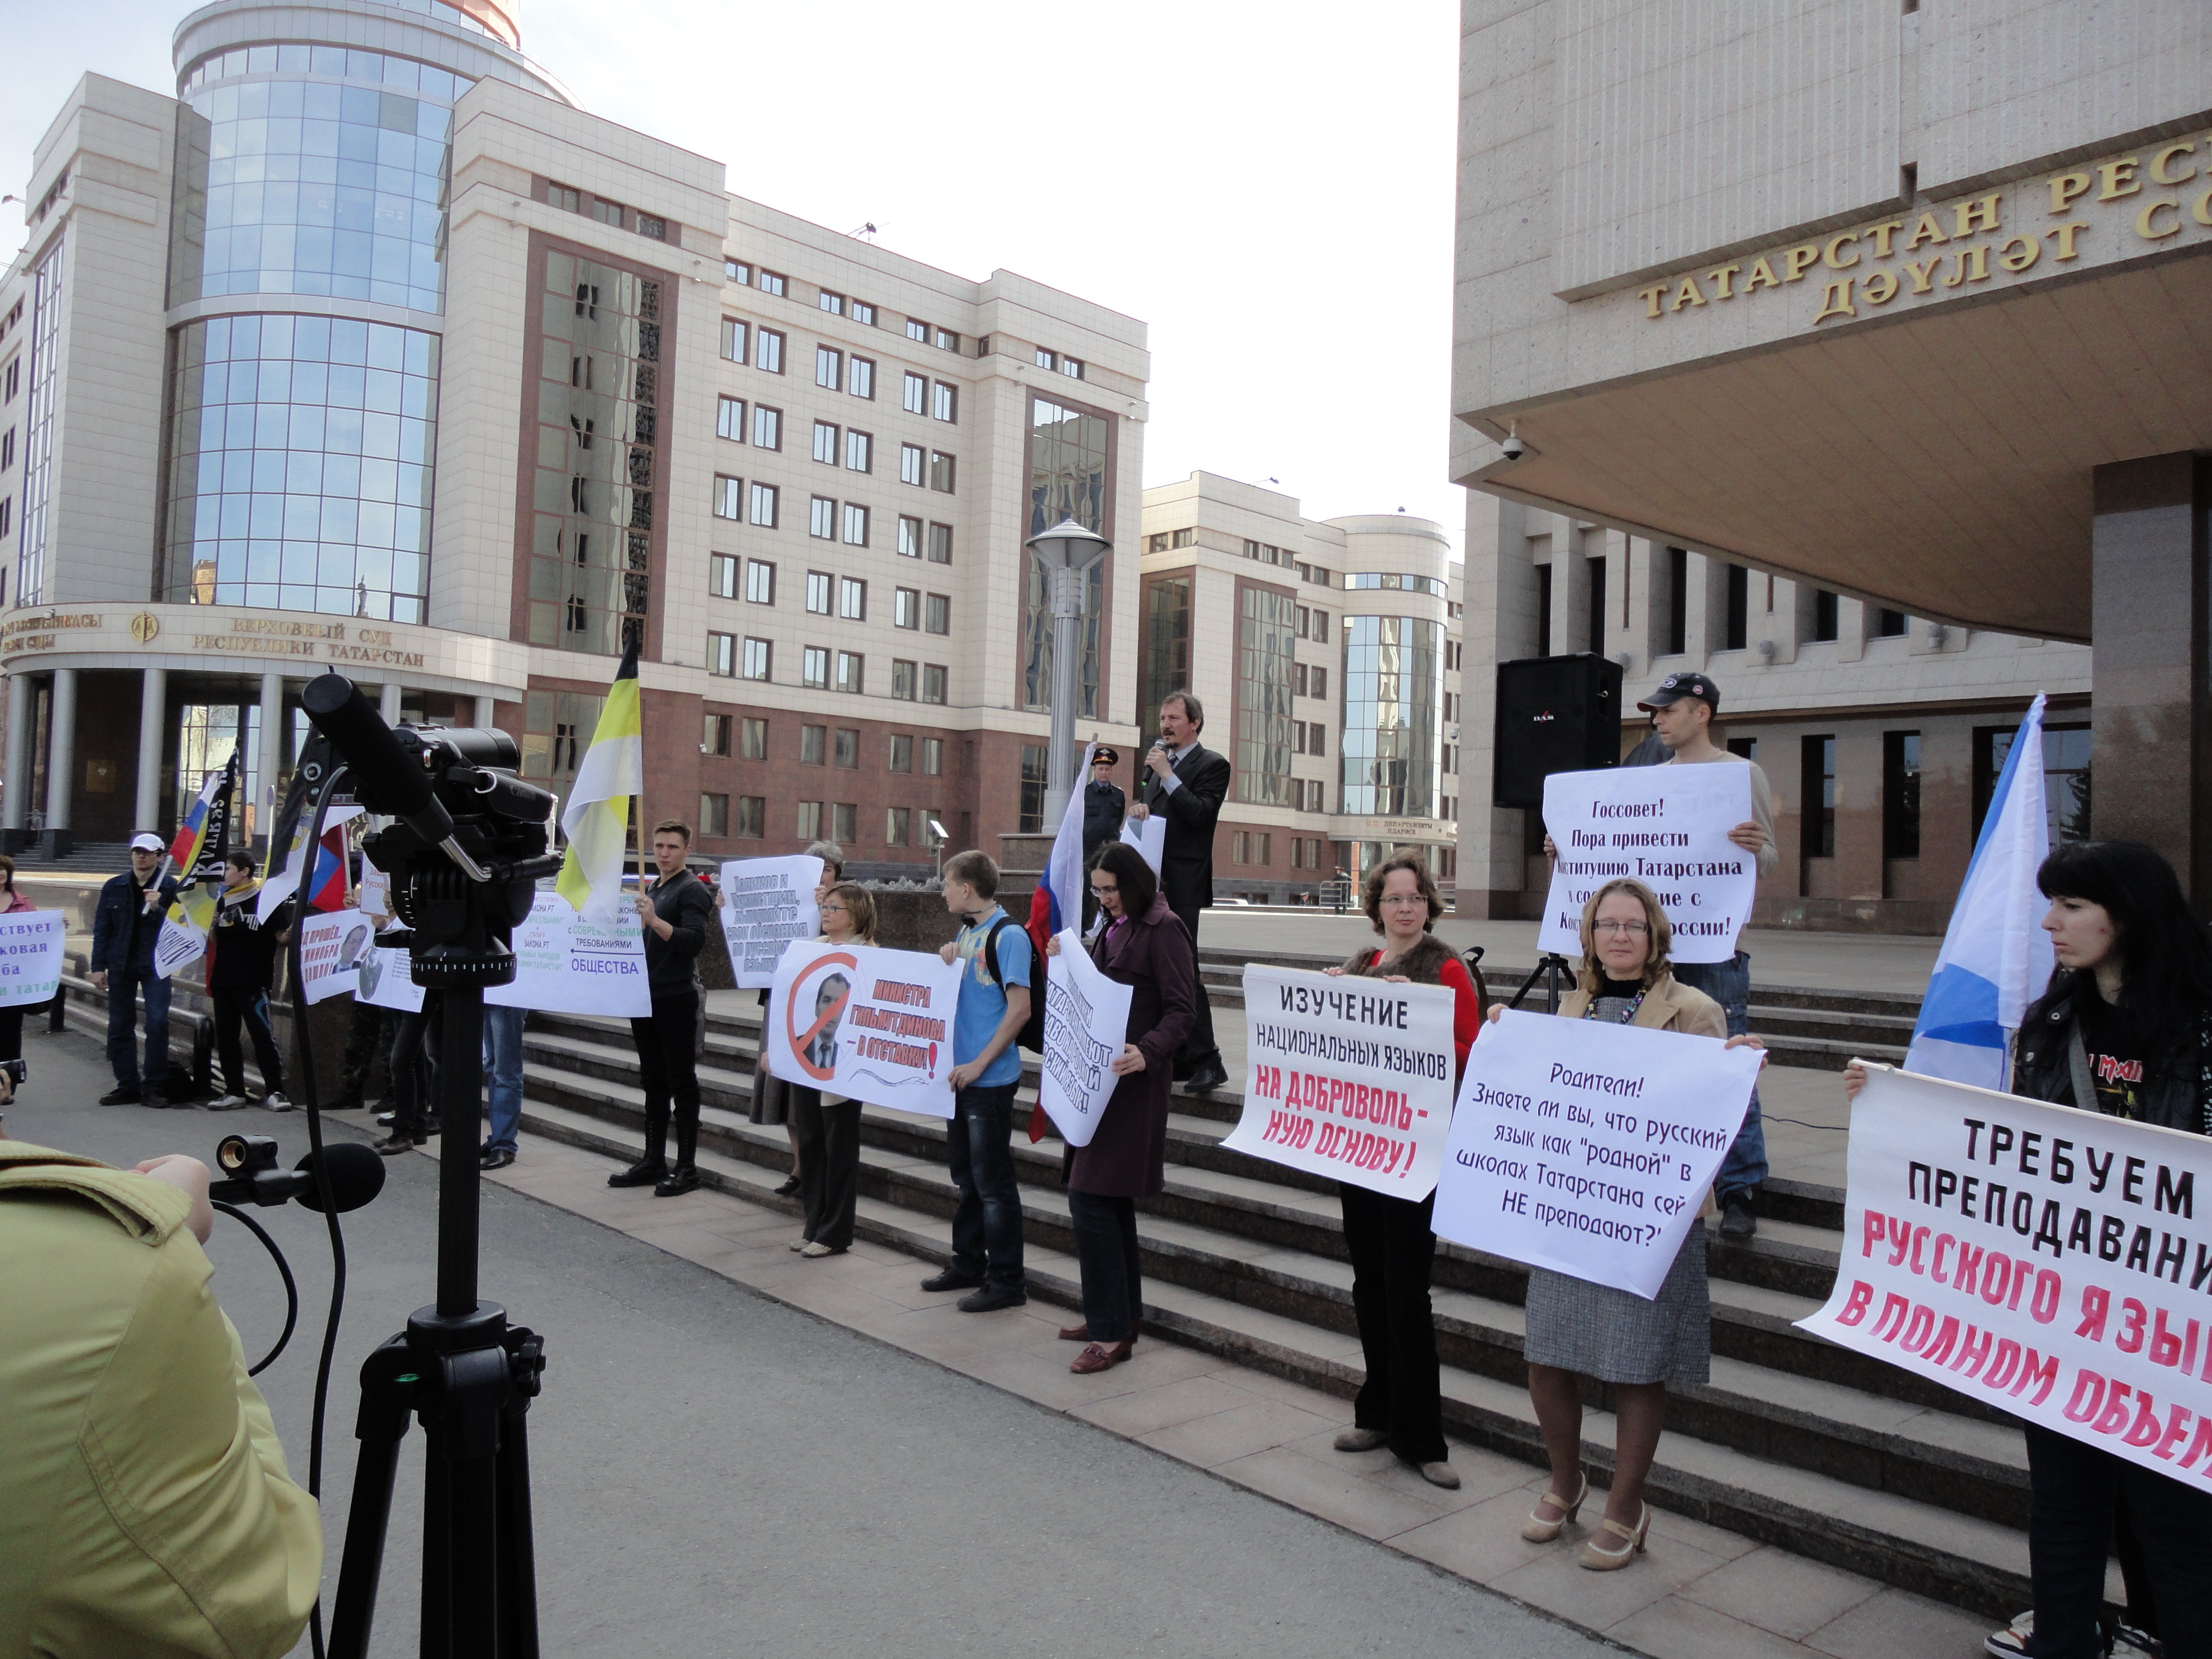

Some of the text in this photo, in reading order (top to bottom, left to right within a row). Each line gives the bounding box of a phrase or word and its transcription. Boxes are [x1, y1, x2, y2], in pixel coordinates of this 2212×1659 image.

[1638, 193, 2003, 320] ТАТАРСТАН
[1814, 221, 2089, 325] ДӘҮЛӘТ
[231, 618, 392, 647] ВЕРХОВНЫЙ СУД
[192, 635, 424, 667] РЕСПУБЛИКИ ТАТАРСТАН
[1592, 798, 1664, 819] Госсовет!
[1571, 830, 1689, 850] Пора привести
[1636, 857, 1742, 881] Татарстана
[576, 938, 632, 949] ТРЕБОВАНИЯМИ
[733, 942, 743, 957] по
[0, 964, 21, 976] ба
[571, 959, 639, 975] ОБЩЕСТВА
[873, 979, 932, 1008] МИНИСТРА
[1280, 985, 1409, 1030] ИЗУЧЕНИЕ
[849, 1004, 946, 1042] ГИЛЬМУТДИНОВА
[857, 1035, 866, 1056] В
[1257, 1023, 1447, 1081] НАЦИОНАЛЬНЫХ ЯЗЫКОВ
[1255, 1064, 1281, 1100] НА
[1550, 1062, 1645, 1099] Родители!
[1473, 1083, 1727, 1152] Знаете ли вы, что русский
[1262, 1109, 1417, 1179] НУЮ ОСНОВУ!
[1494, 1124, 1535, 1147] язык
[1542, 1134, 1571, 1156] как
[1580, 1137, 1670, 1176] "родной"
[1456, 1148, 1527, 1181] школах
[1537, 1162, 1644, 1208] Татарстана
[1963, 1117, 2195, 1220] ТРЕБУЕМ
[1502, 1189, 1527, 1215] НЕ
[1861, 1209, 2061, 1325] РУССКОГО
[1835, 1279, 1874, 1328] В
[1868, 1292, 2059, 1408] ПОЛНОМ
